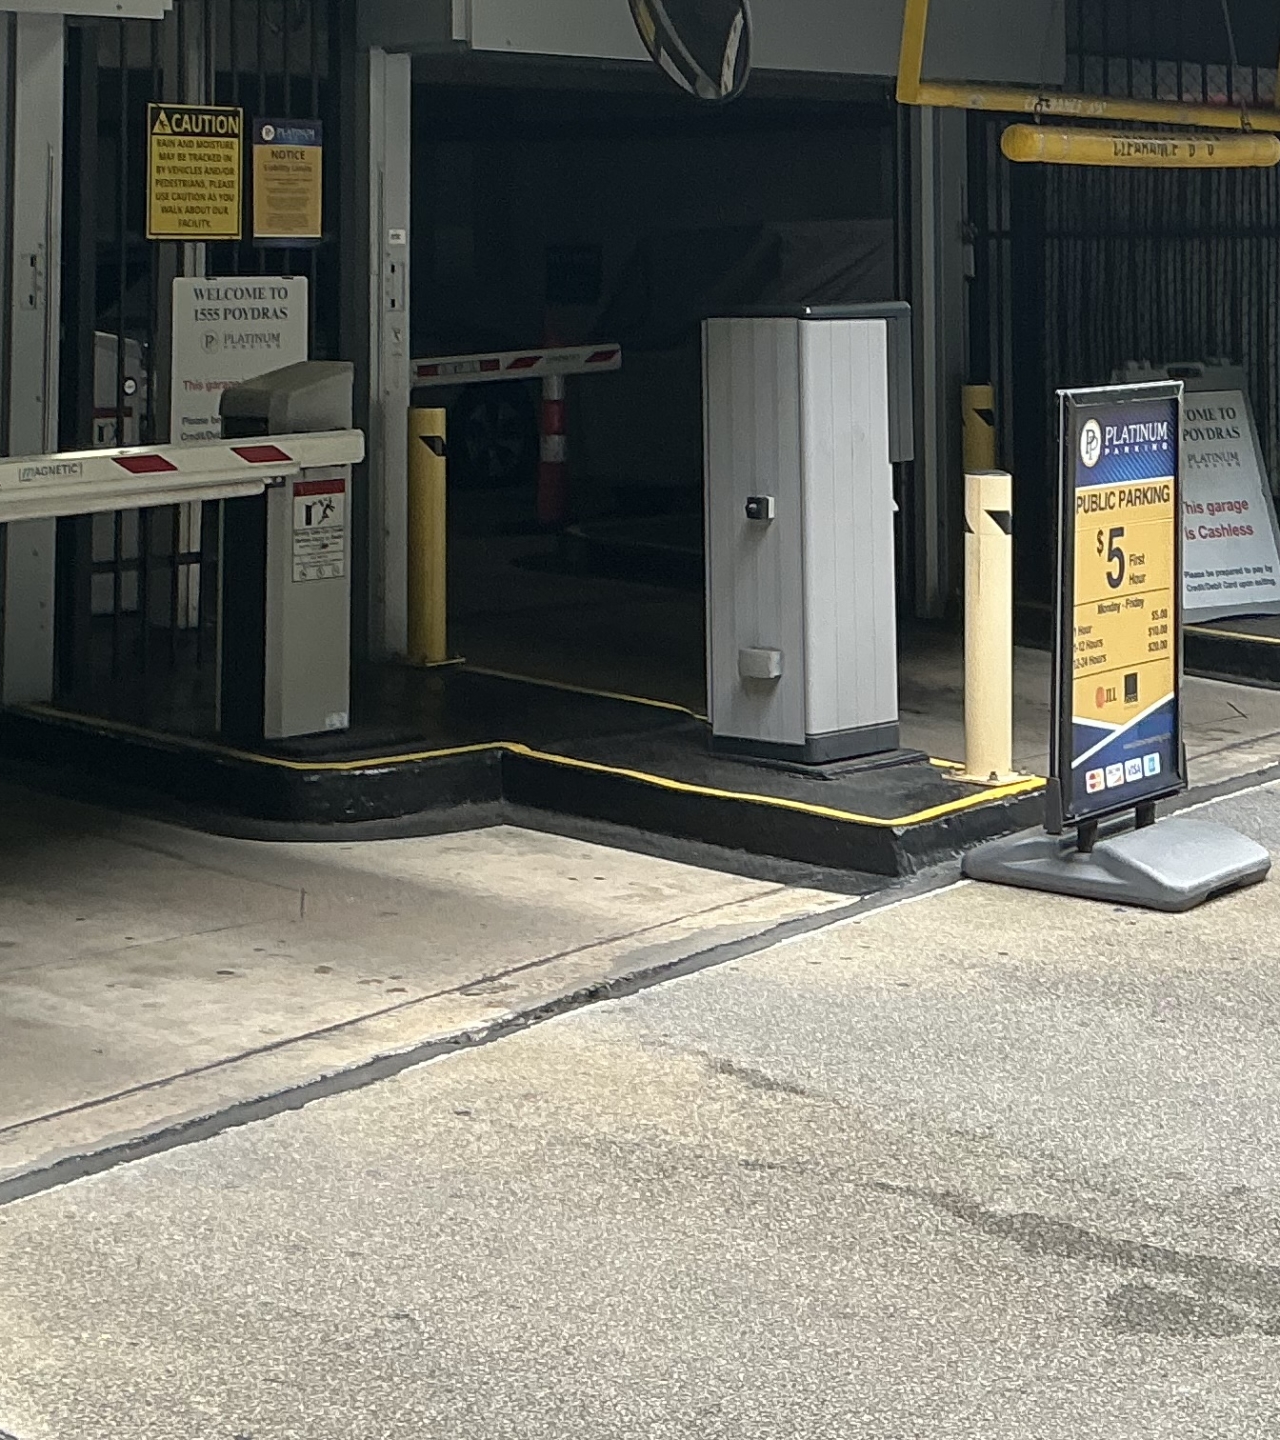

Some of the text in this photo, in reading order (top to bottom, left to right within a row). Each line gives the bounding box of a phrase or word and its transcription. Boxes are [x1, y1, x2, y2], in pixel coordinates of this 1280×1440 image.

[171, 113, 239, 134] CAUTION
[177, 139, 194, 148] AND
[271, 150, 306, 160] NOTICE
[168, 165, 202, 175] VEHICLES
[209, 179, 235, 189] PLEASE
[155, 192, 235, 202] USE CAUTION AS YOU
[184, 206, 210, 215] ABOUT
[211, 206, 229, 215] OUR
[193, 287, 288, 300] WELCOME TO
[194, 307, 288, 321] 1555 POYDRAS
[224, 332, 281, 344] PLATINUM
[182, 380, 204, 391] This
[1220, 407, 1236, 420] TO
[1104, 422, 1169, 446] PLATINUM
[1104, 442, 1169, 457] PARKING
[1076, 484, 1170, 514] PUBLIC PARKING
[1207, 499, 1249, 515] garage
[1198, 524, 1254, 540] Cashless
